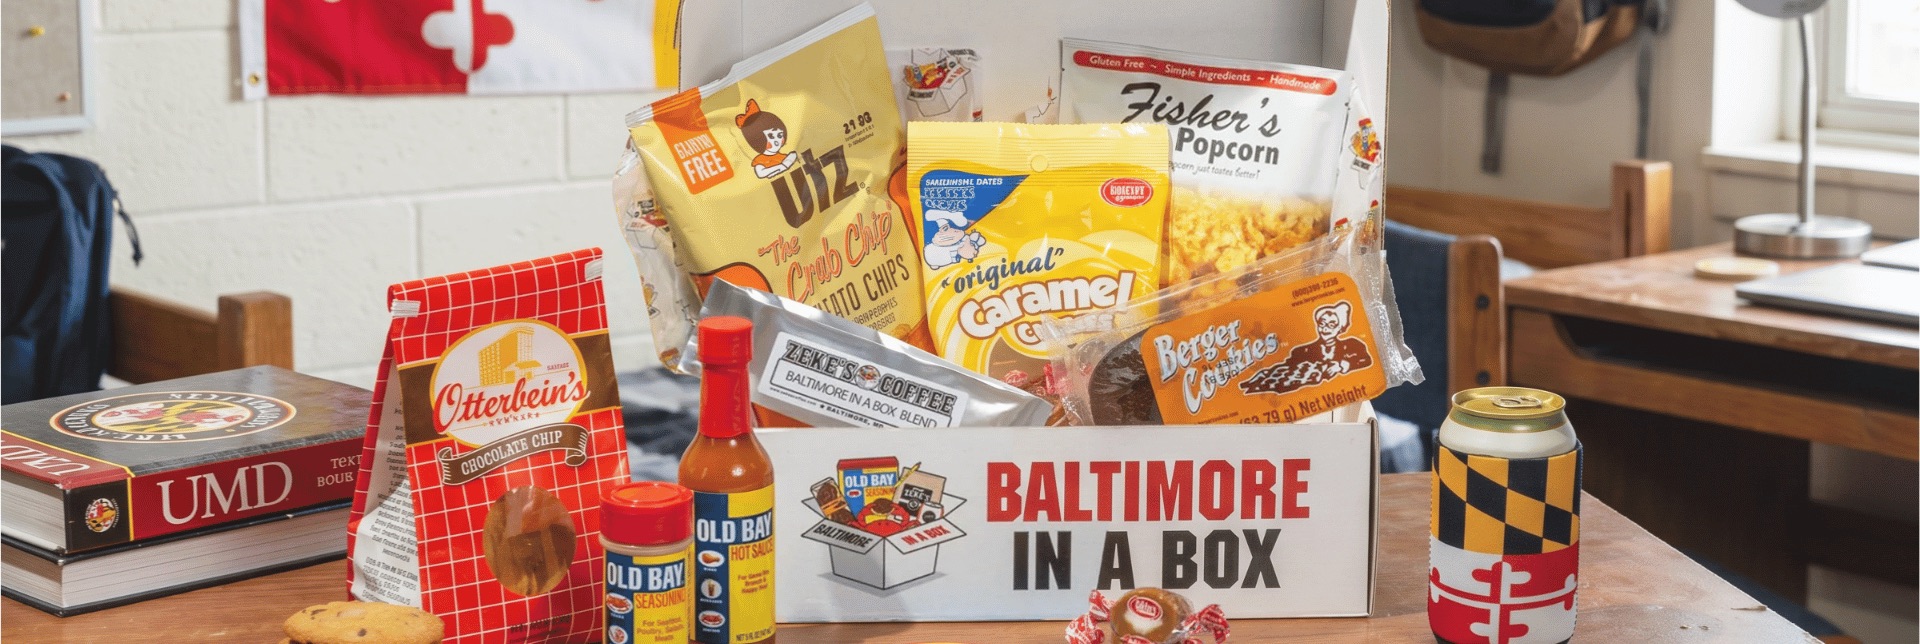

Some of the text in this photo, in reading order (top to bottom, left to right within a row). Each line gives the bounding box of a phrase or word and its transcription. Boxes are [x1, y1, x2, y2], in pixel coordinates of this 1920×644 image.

[1089, 55, 1321, 89] Gluten Free Simple Ingredients Handmade
[1121, 82, 1281, 138] Fisher's
[683, 149, 727, 184] FREE
[1175, 127, 1279, 165] Popcorn
[771, 145, 859, 228] Utz
[1192, 166, 1210, 175] just
[786, 237, 843, 303] Crab
[862, 253, 911, 302] CHIPS
[958, 270, 1136, 340] Caramel
[1154, 320, 1240, 382] Berger
[1184, 333, 1278, 415] Cookies
[783, 339, 958, 415] ZEKE'S COFFEE
[785, 370, 937, 428] BALTIMORE IN A BOX BLEND
[1298, 400, 1321, 414] Net
[1322, 384, 1369, 407] Weight
[434, 371, 591, 434] Otterbein's
[826, 406, 870, 426] BALTIMORE,
[461, 430, 562, 475] CHOCOLATE CHIP
[156, 462, 293, 525] UMD
[845, 474, 894, 488] OLD BAY
[987, 459, 1311, 522] BALTIMORE
[696, 512, 772, 543] OLD BAY
[813, 524, 873, 548] BALTIMORE
[915, 532, 928, 541] A
[923, 525, 951, 538] BOX
[731, 545, 750, 560] HOT
[1013, 529, 1282, 590] IN A BOX
[607, 562, 684, 591] OLD BAY
